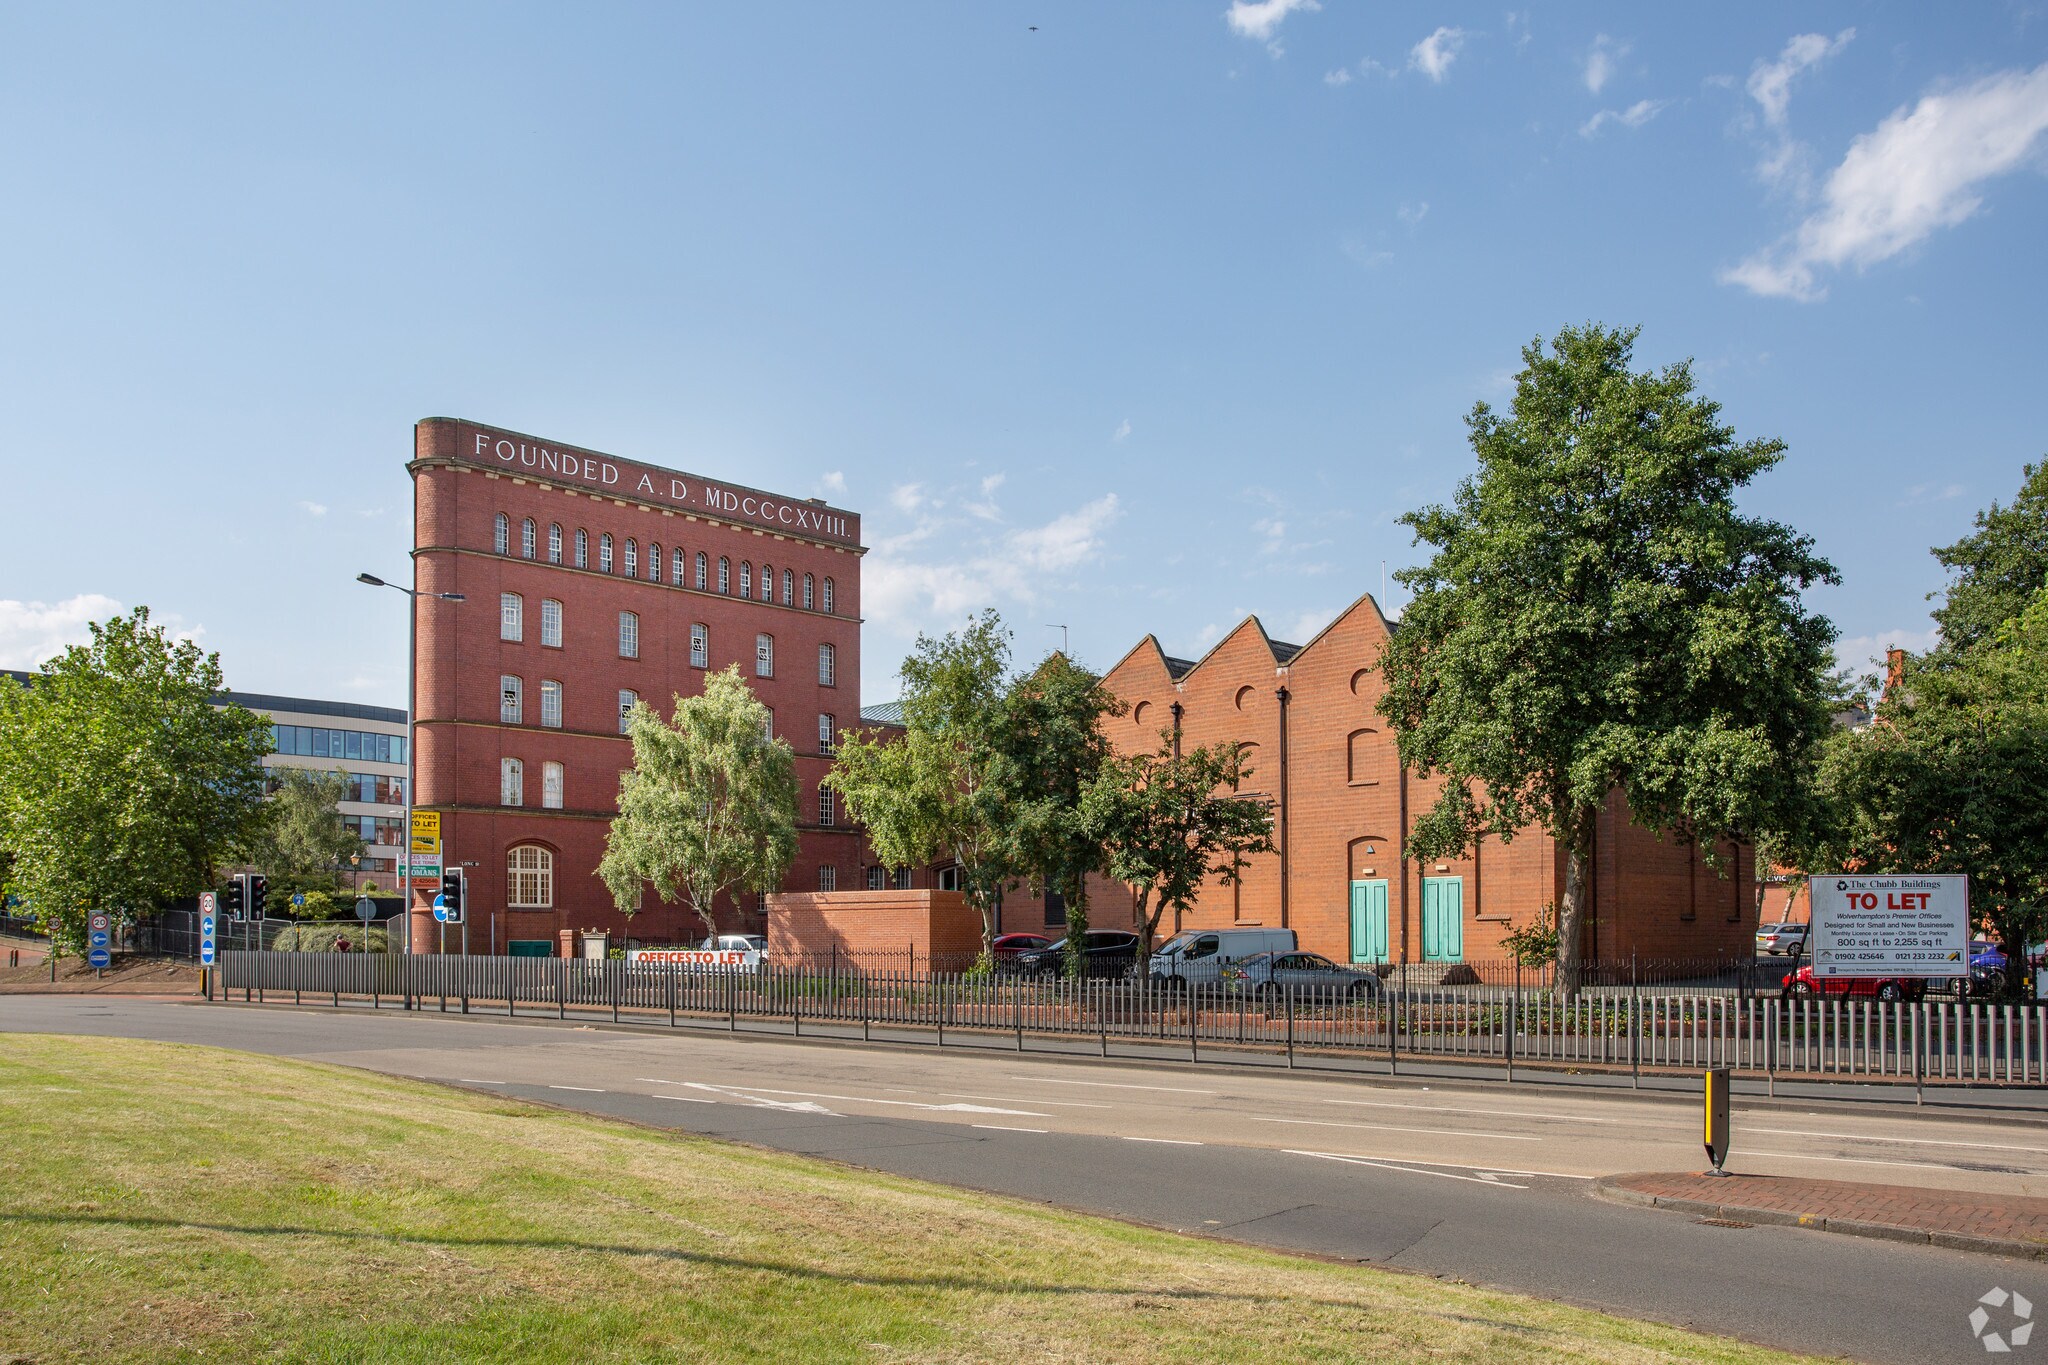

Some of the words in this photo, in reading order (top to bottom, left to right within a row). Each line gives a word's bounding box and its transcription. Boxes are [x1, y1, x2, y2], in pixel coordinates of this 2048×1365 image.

[475, 433, 619, 484] FOUNDED
[400, 869, 437, 877] TOMANS
[1850, 880, 1867, 888] The
[1869, 880, 1898, 888] Chubb
[1901, 880, 1941, 890] Buildings
[204, 899, 212, 907] 20
[1846, 893, 1878, 910] TO
[1888, 893, 1932, 910] LET
[1837, 938, 1856, 947] 800
[1858, 940, 1870, 948] sq
[1872, 938, 1880, 946] ft
[1882, 938, 1892, 946] to
[1894, 938, 1919, 947] 2,255
[1921, 940, 1933, 948] sq
[1935, 938, 1943, 946] ft
[638, 952, 692, 963] OFFICES
[694, 952, 714, 964] TO
[719, 952, 746, 964] LET
